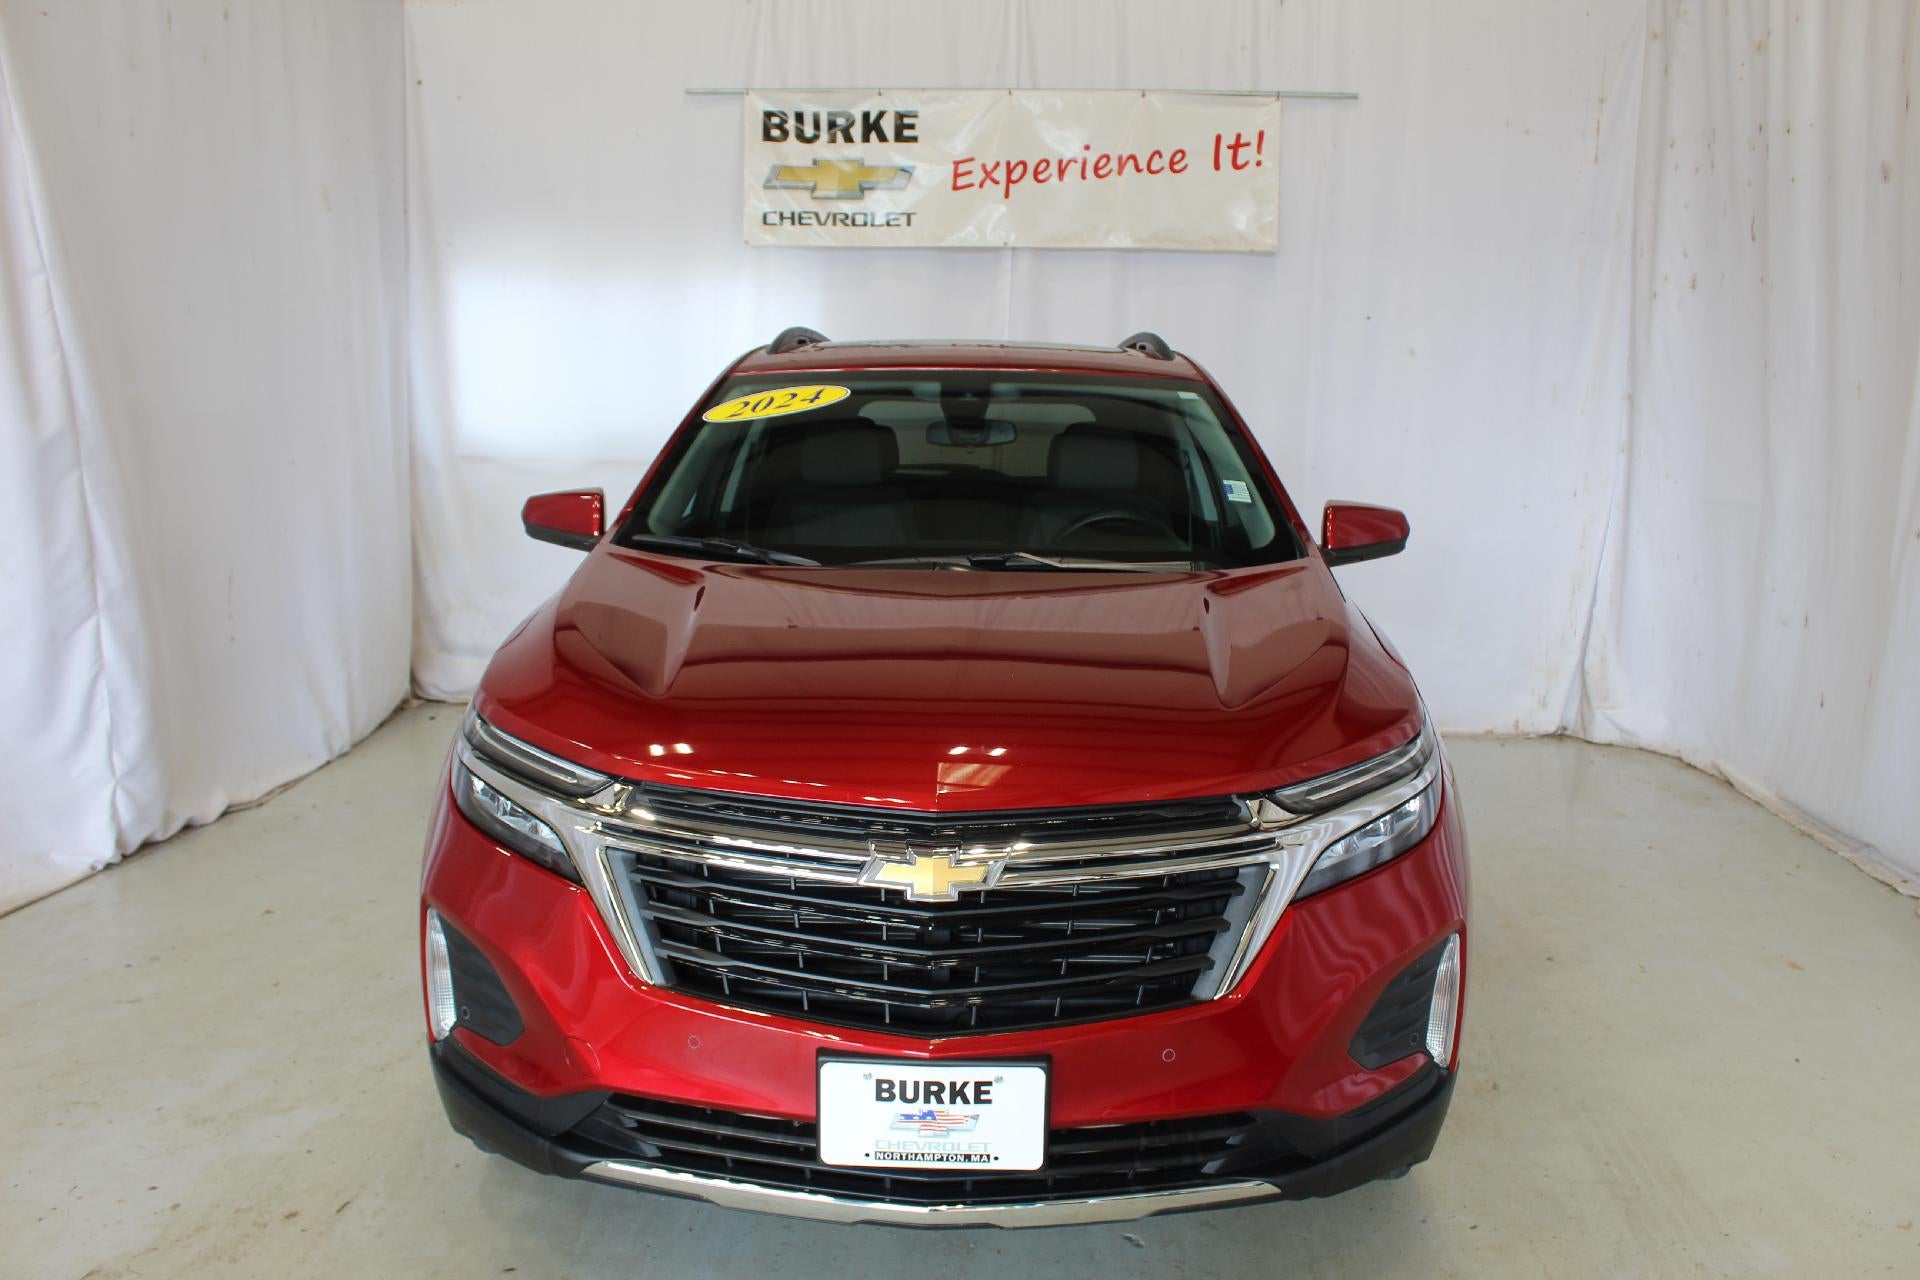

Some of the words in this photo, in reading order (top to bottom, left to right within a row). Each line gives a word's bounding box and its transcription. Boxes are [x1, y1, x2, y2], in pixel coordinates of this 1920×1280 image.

[762, 110, 919, 143] BURKE
[951, 144, 1189, 199] Experience
[1213, 130, 1266, 172] It!
[762, 210, 917, 228] CHEVROLET
[726, 388, 826, 418] 2024
[875, 1078, 993, 1105] BURKE
[875, 1139, 992, 1153] CHEVROLET
